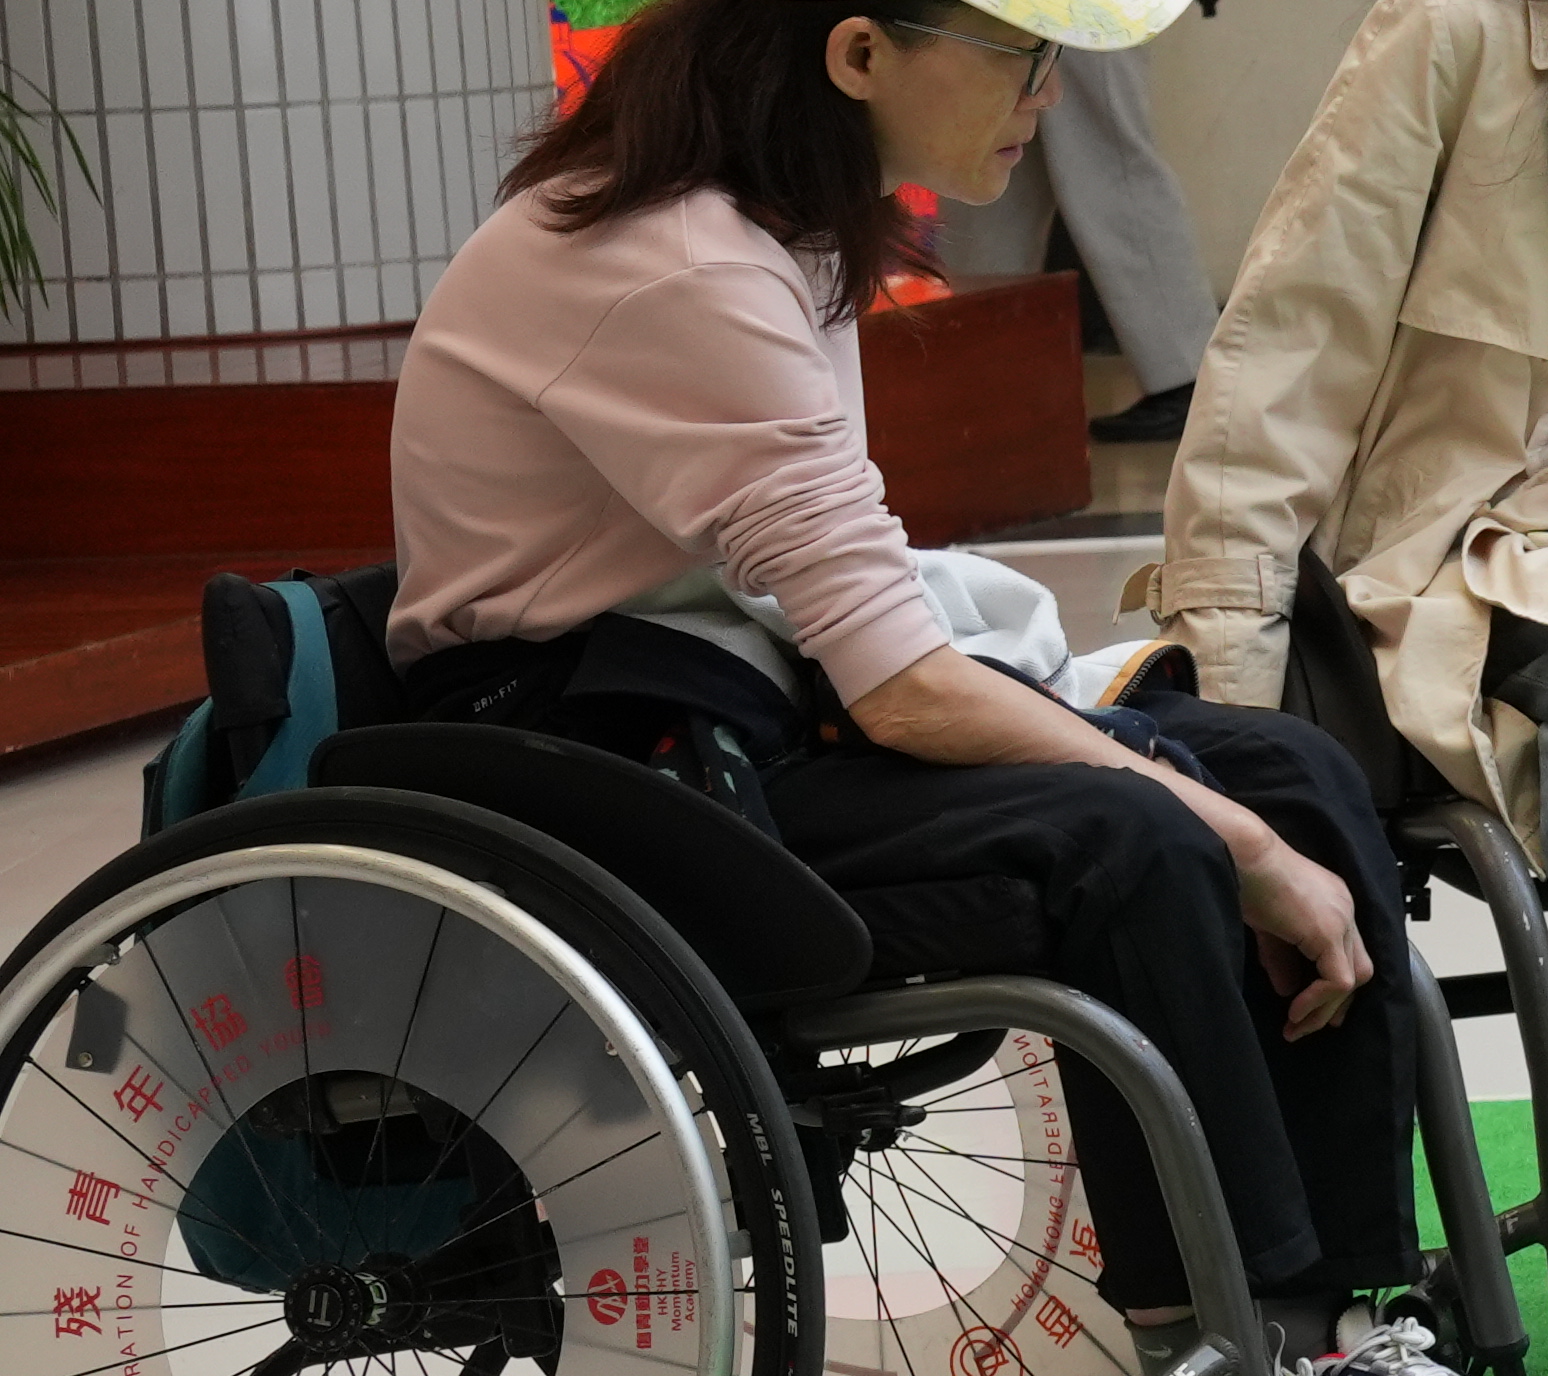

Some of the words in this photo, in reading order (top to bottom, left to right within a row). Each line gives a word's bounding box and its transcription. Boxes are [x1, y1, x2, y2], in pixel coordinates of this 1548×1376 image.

[118, 1224, 140, 1258] OF
[132, 1054, 253, 1210] HANDICAPPED
[745, 1112, 776, 1168] MBL
[771, 1187, 798, 1339] SPEEDLITE
